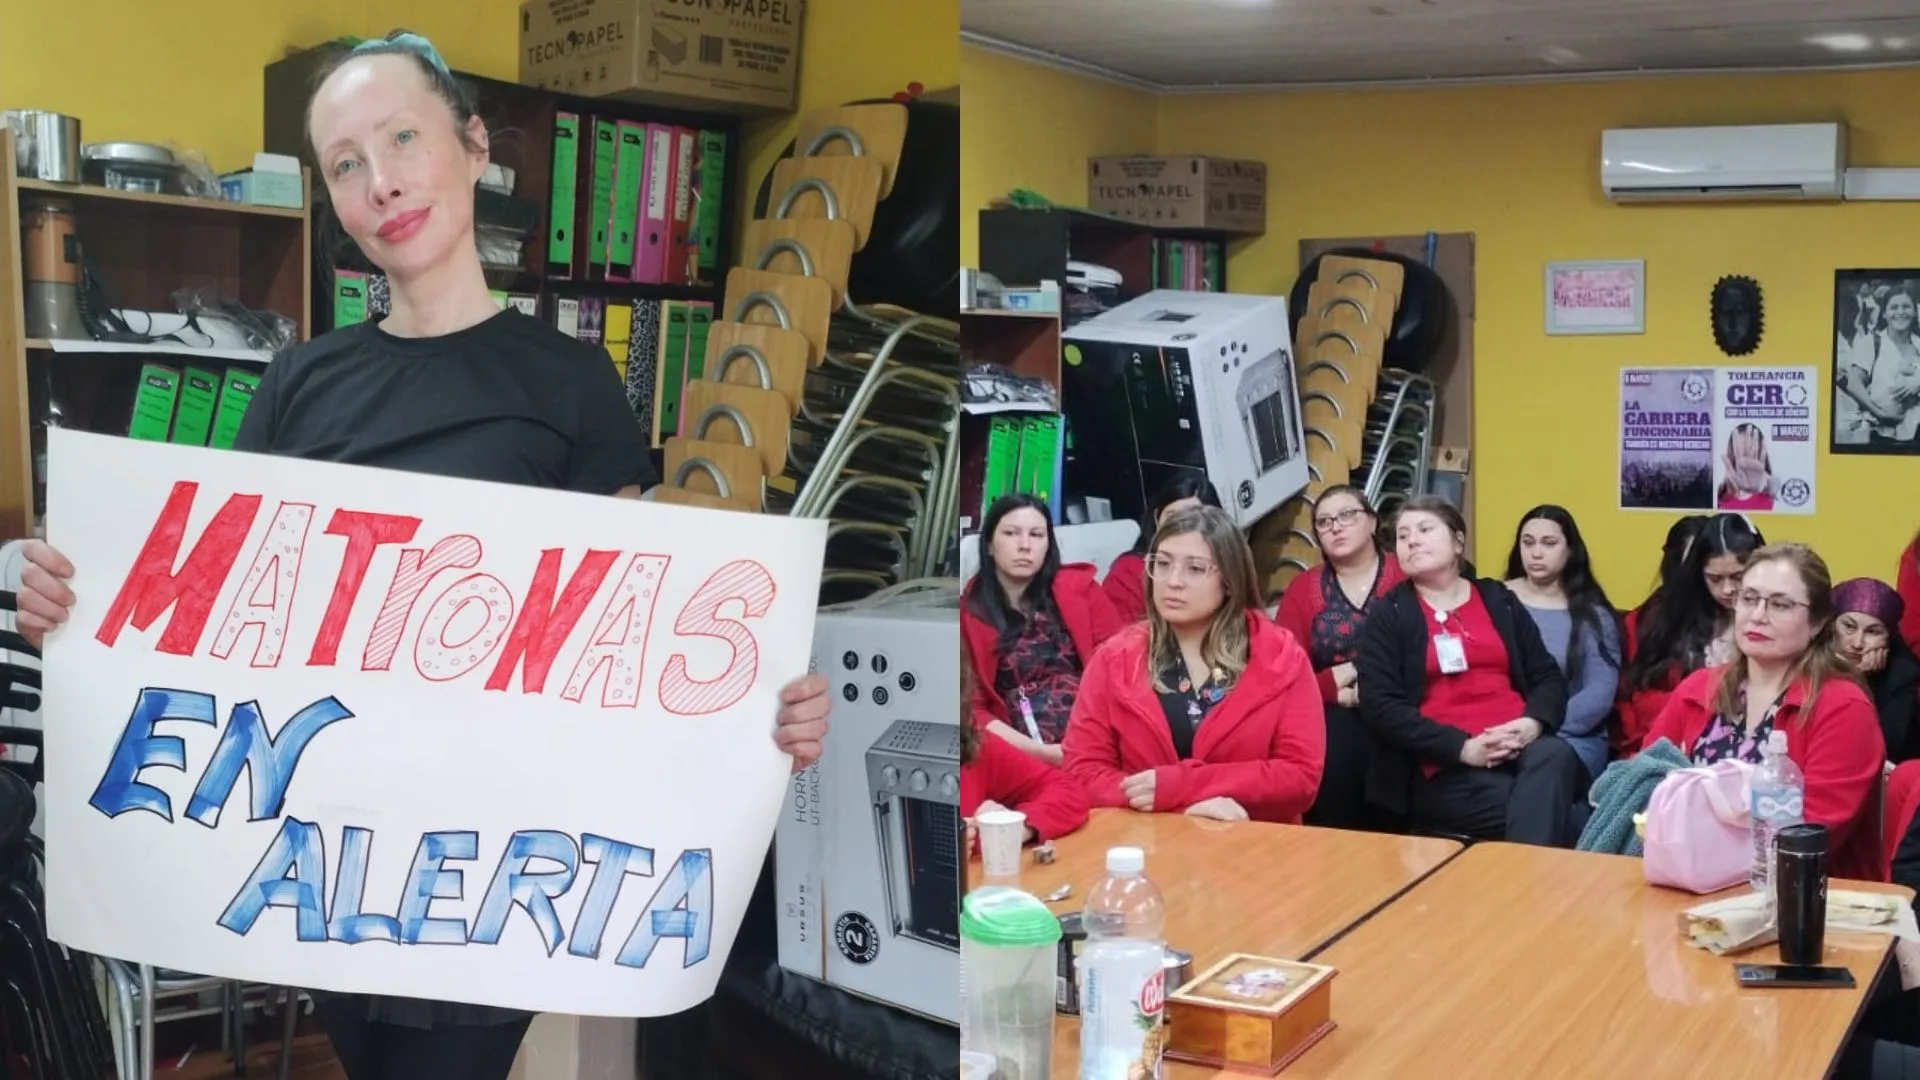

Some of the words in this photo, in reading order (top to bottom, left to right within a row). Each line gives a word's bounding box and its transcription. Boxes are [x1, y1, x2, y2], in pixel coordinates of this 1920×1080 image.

[1728, 372, 1805, 380] TOLERANCIA
[1624, 400, 1640, 410] LA
[1624, 412, 1711, 425] CARRERA
[1624, 427, 1711, 437] FUNCIONARIA
[88, 686, 356, 830] EN
[794, 768, 808, 823] HORN
[216, 815, 713, 969] ALERTA
[845, 928, 863, 947] 2
